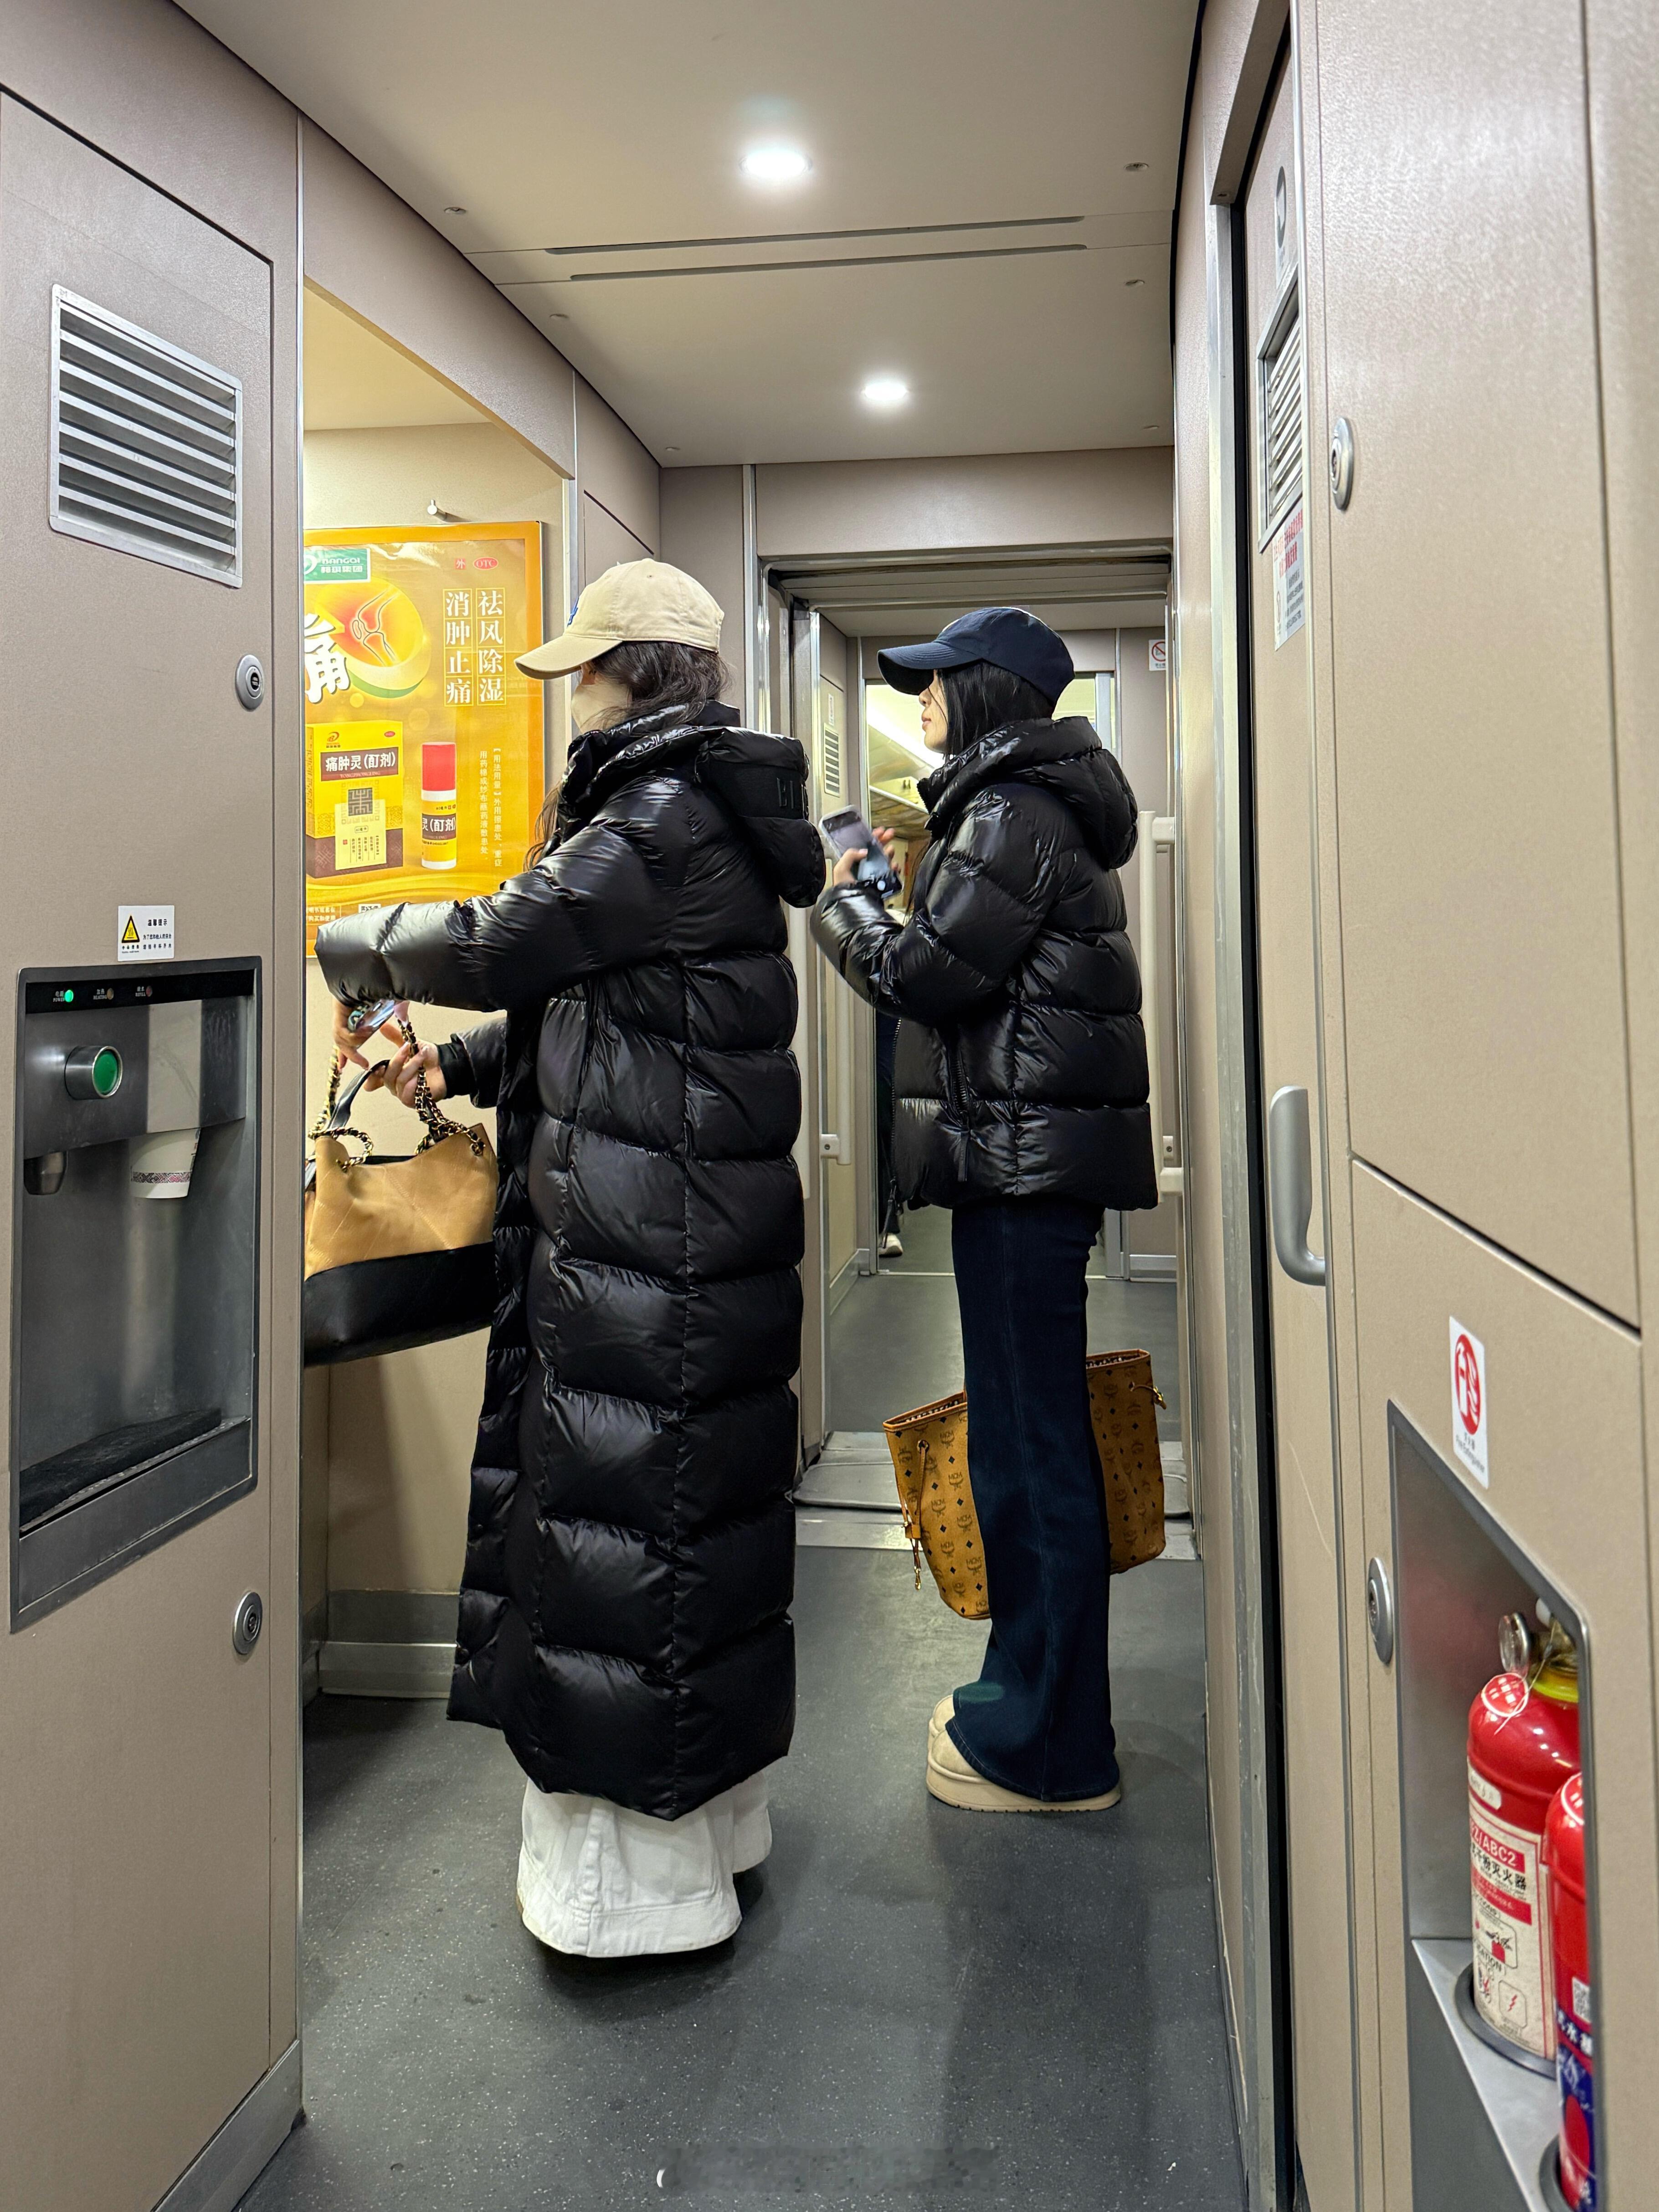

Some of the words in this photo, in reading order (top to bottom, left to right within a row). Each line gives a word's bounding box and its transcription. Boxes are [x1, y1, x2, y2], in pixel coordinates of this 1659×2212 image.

[446, 591, 471, 703] 消肿止痛
[478, 590, 504, 702] 祛风除湿
[326, 752, 395, 771] 痛肿灵(酊剂)
